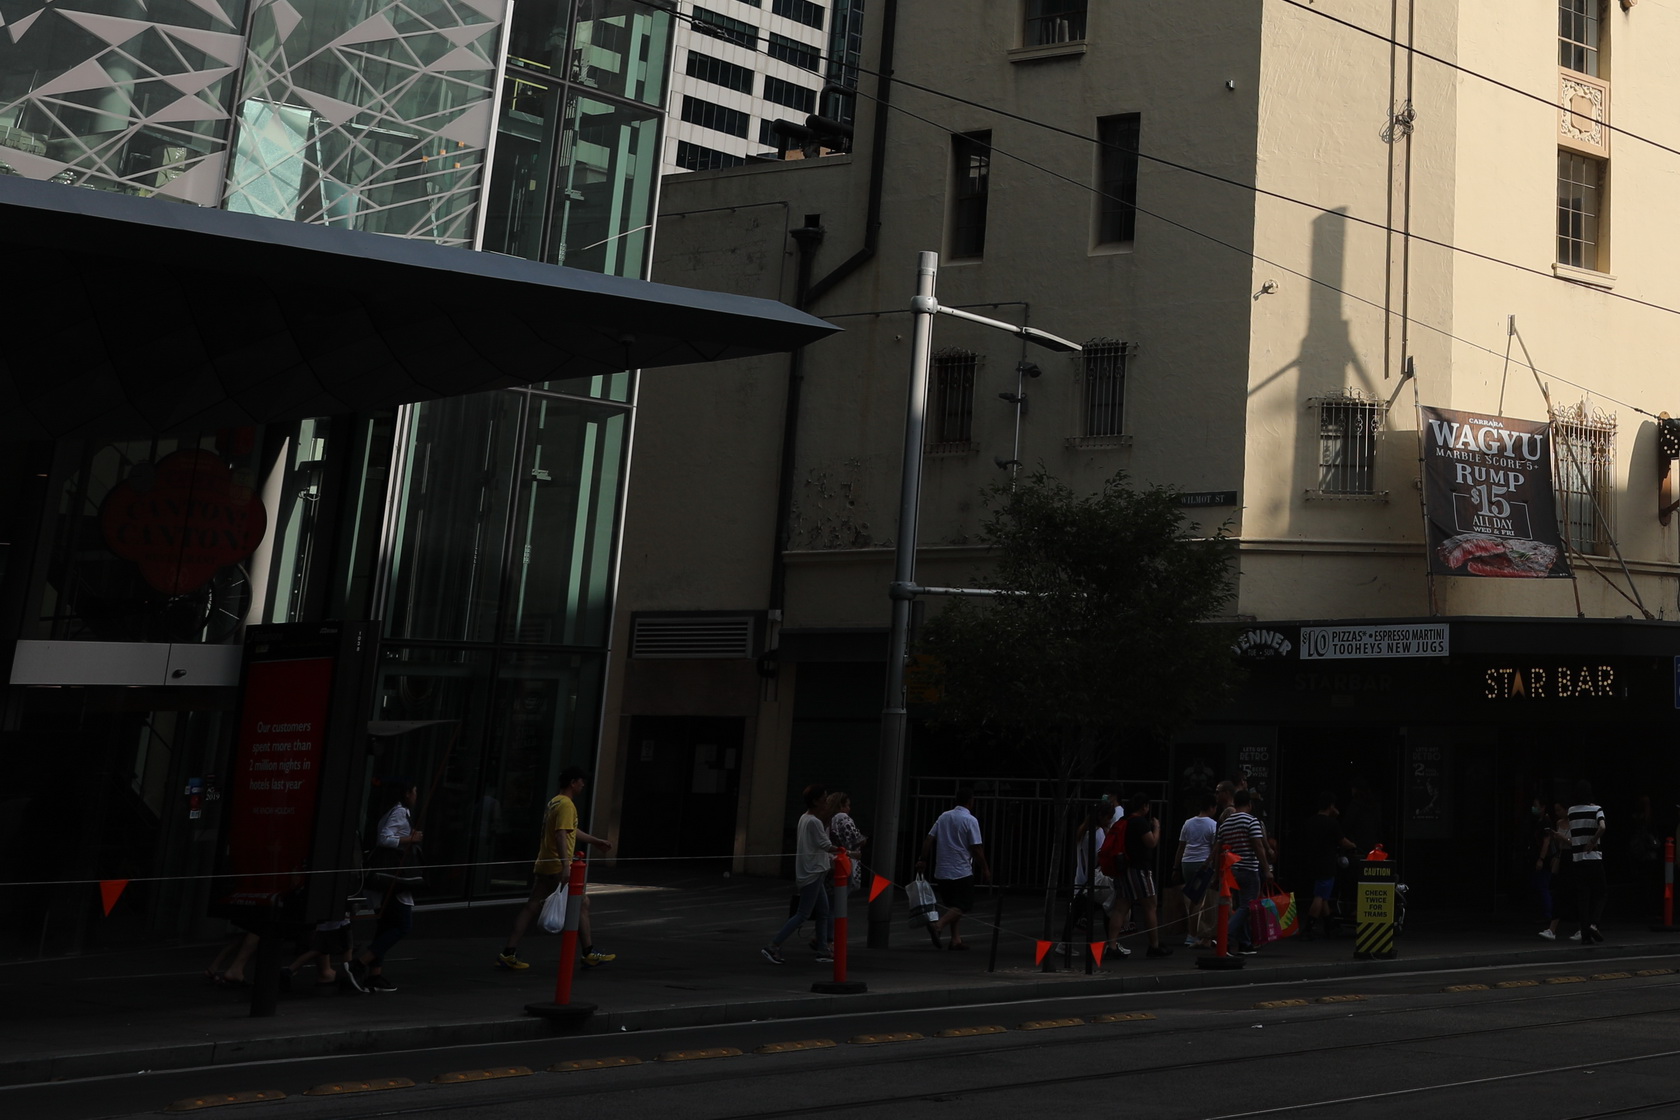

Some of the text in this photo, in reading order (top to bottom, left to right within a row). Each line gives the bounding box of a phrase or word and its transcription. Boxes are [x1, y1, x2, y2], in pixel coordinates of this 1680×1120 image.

[1468, 417, 1504, 428] CARRARA
[1428, 418, 1544, 461] WAGYU
[1435, 446, 1539, 471] MARBLE SCORE 5+
[1454, 462, 1525, 492] RUMP
[1215, 495, 1225, 503] ST
[1470, 484, 1511, 519] $15
[1472, 514, 1513, 530] ALL DAY
[1473, 525, 1492, 533] WED
[1501, 528, 1515, 537] FRI
[1373, 629, 1411, 642] ESPRESSO
[1411, 628, 1445, 641] MARTINI
[1301, 629, 1330, 658] $10
[1332, 640, 1444, 656] TOOHEYS NEW JUGS
[1294, 672, 1393, 692] STARBAR
[1484, 665, 1614, 700] STAR BAR
[257, 721, 311, 733] Our customers
[252, 739, 312, 756] spent more than
[1239, 752, 1270, 761] RETRO
[1412, 752, 1441, 761] RETRO
[249, 757, 311, 774] 2 million nights in
[249, 778, 270, 790] hotels
[271, 778, 284, 790] last
[1363, 867, 1391, 877] CAUTION
[1364, 889, 1388, 897] CHECK
